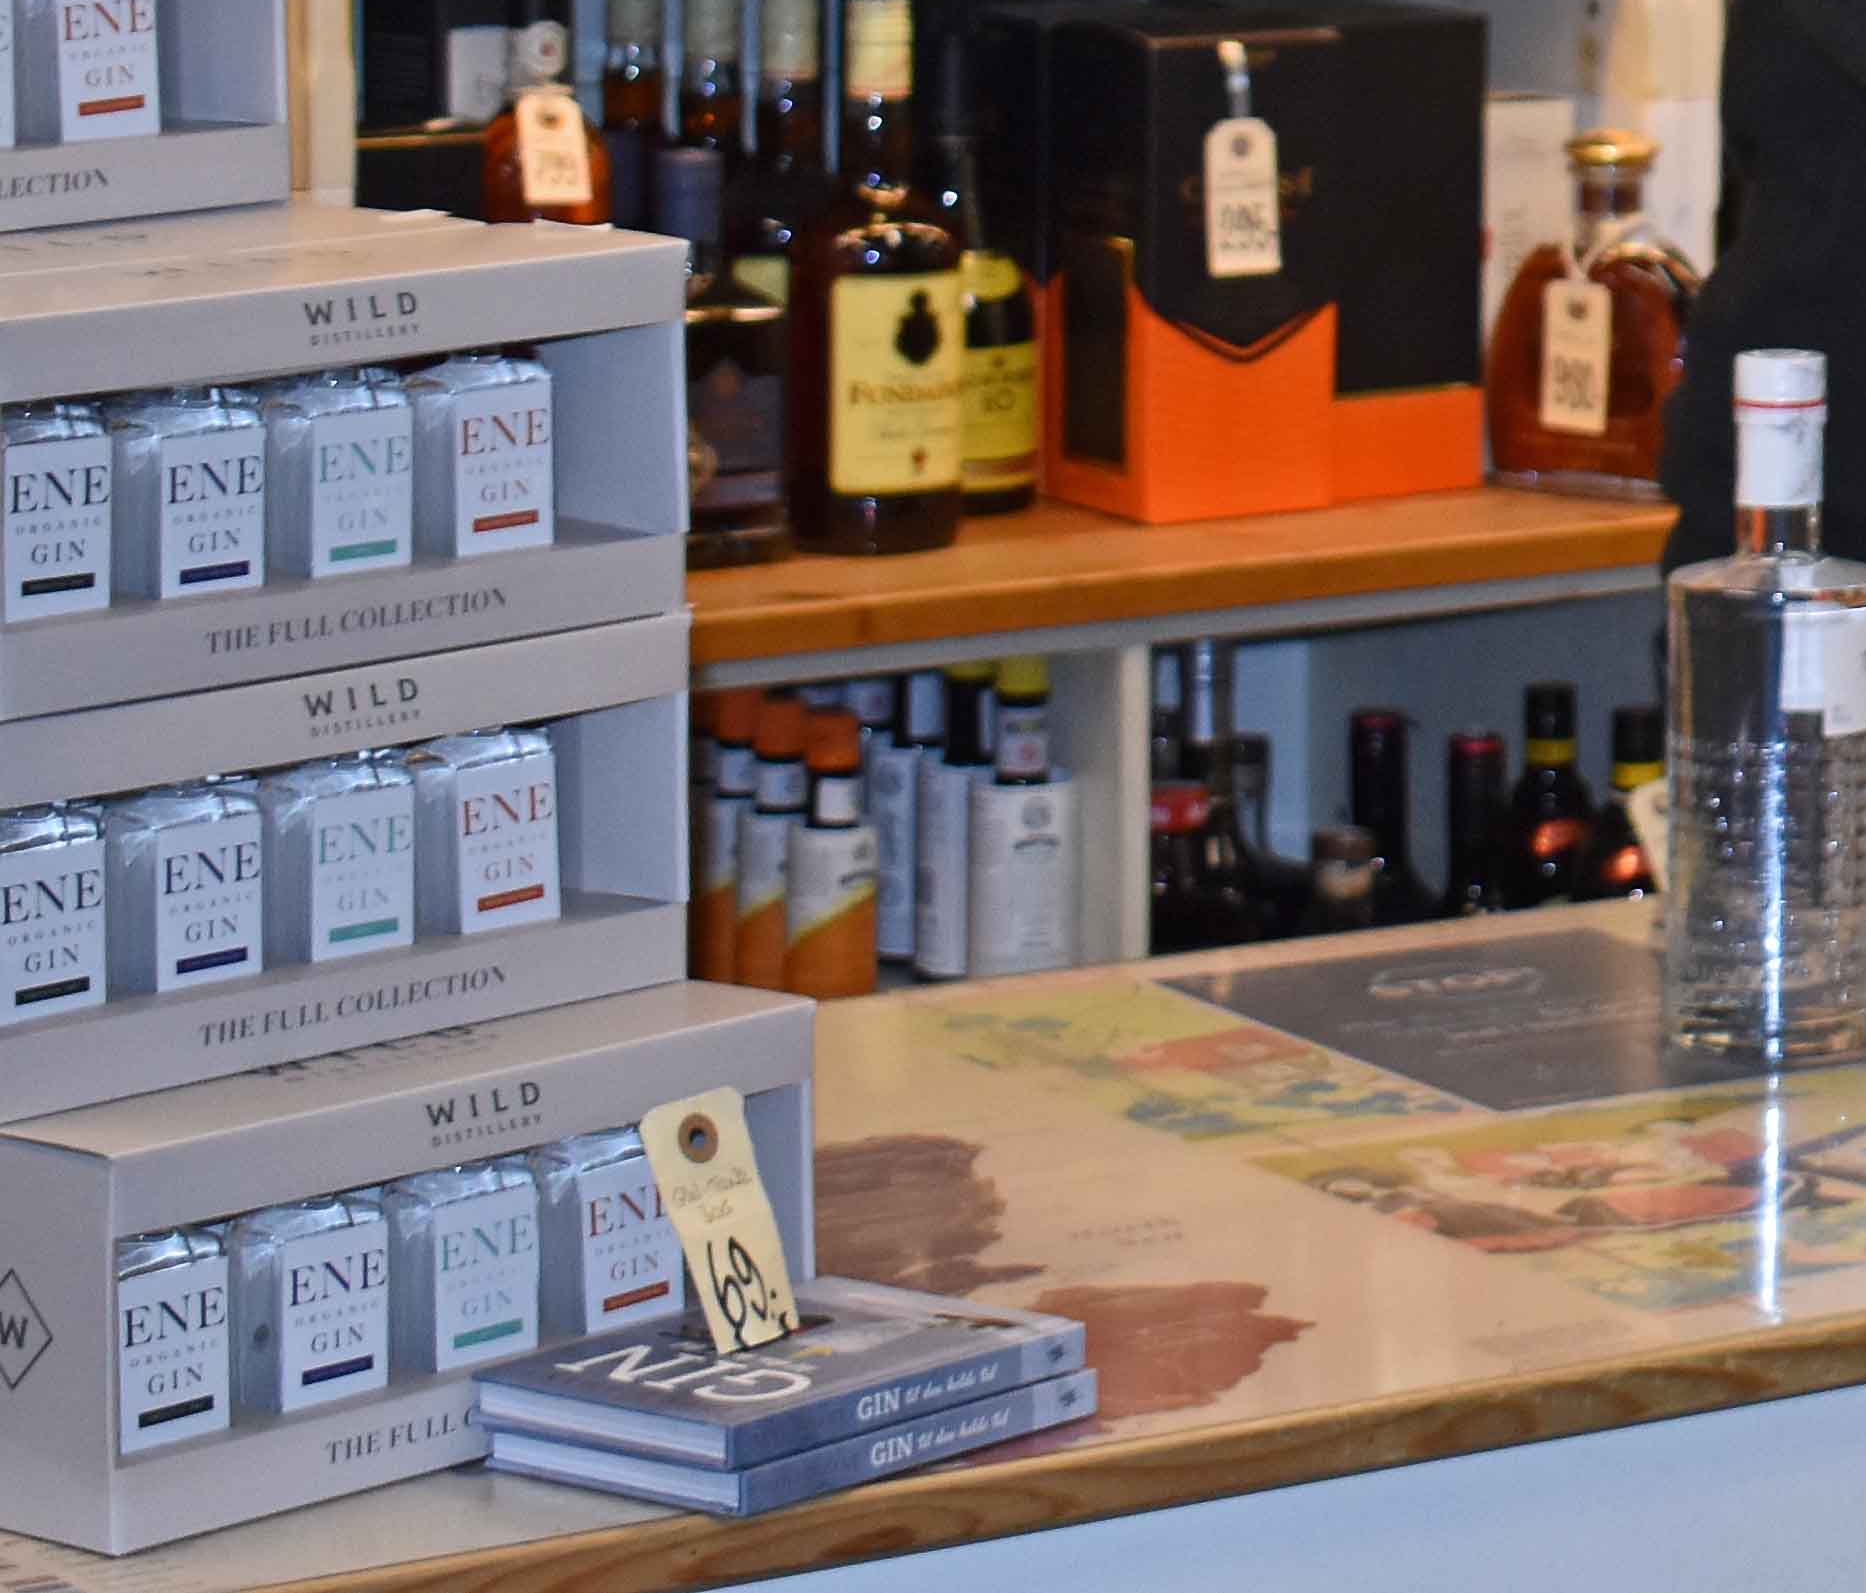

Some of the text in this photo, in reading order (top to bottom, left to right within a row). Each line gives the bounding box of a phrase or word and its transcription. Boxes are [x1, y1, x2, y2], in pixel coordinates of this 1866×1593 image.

[85, 63, 135, 89] GIN
[305, 292, 417, 326] WILD
[309, 324, 420, 347] DISTILLERY
[461, 408, 549, 456] ENE
[319, 434, 410, 483] ENE
[11, 464, 109, 515] ENE
[168, 455, 263, 504] ENE
[480, 479, 529, 504] GIN
[337, 510, 388, 533] GIN
[30, 538, 87, 565] GIN
[189, 528, 241, 553] GIN
[205, 587, 508, 654] THE FULL COLLECTION
[304, 677, 419, 718] WILD
[462, 781, 554, 837] ENE
[318, 814, 413, 865] ENE
[163, 840, 261, 896] ENE
[483, 853, 536, 882] GIN
[1, 868, 104, 926] ENE
[337, 887, 389, 913] GIN
[184, 914, 239, 945] GIN
[24, 943, 80, 975] GIN
[200, 964, 507, 1047] THE FULL COLLECTION
[426, 1080, 541, 1127] WILD
[431, 1113, 543, 1149] DISTILLERY
[440, 1213, 535, 1273] ENE
[288, 1247, 388, 1308] ENE
[609, 1252, 659, 1281] GIN
[121, 1285, 226, 1350] ENE
[460, 1287, 512, 1319] GIN
[309, 1322, 365, 1354] GIN
[147, 1363, 206, 1397] GIN
[552, 1344, 812, 1403] GIN
[856, 1385, 902, 1421] GIN
[325, 1431, 381, 1464] THE
[389, 1412, 456, 1449] FULL
[869, 1432, 914, 1467] GIN
